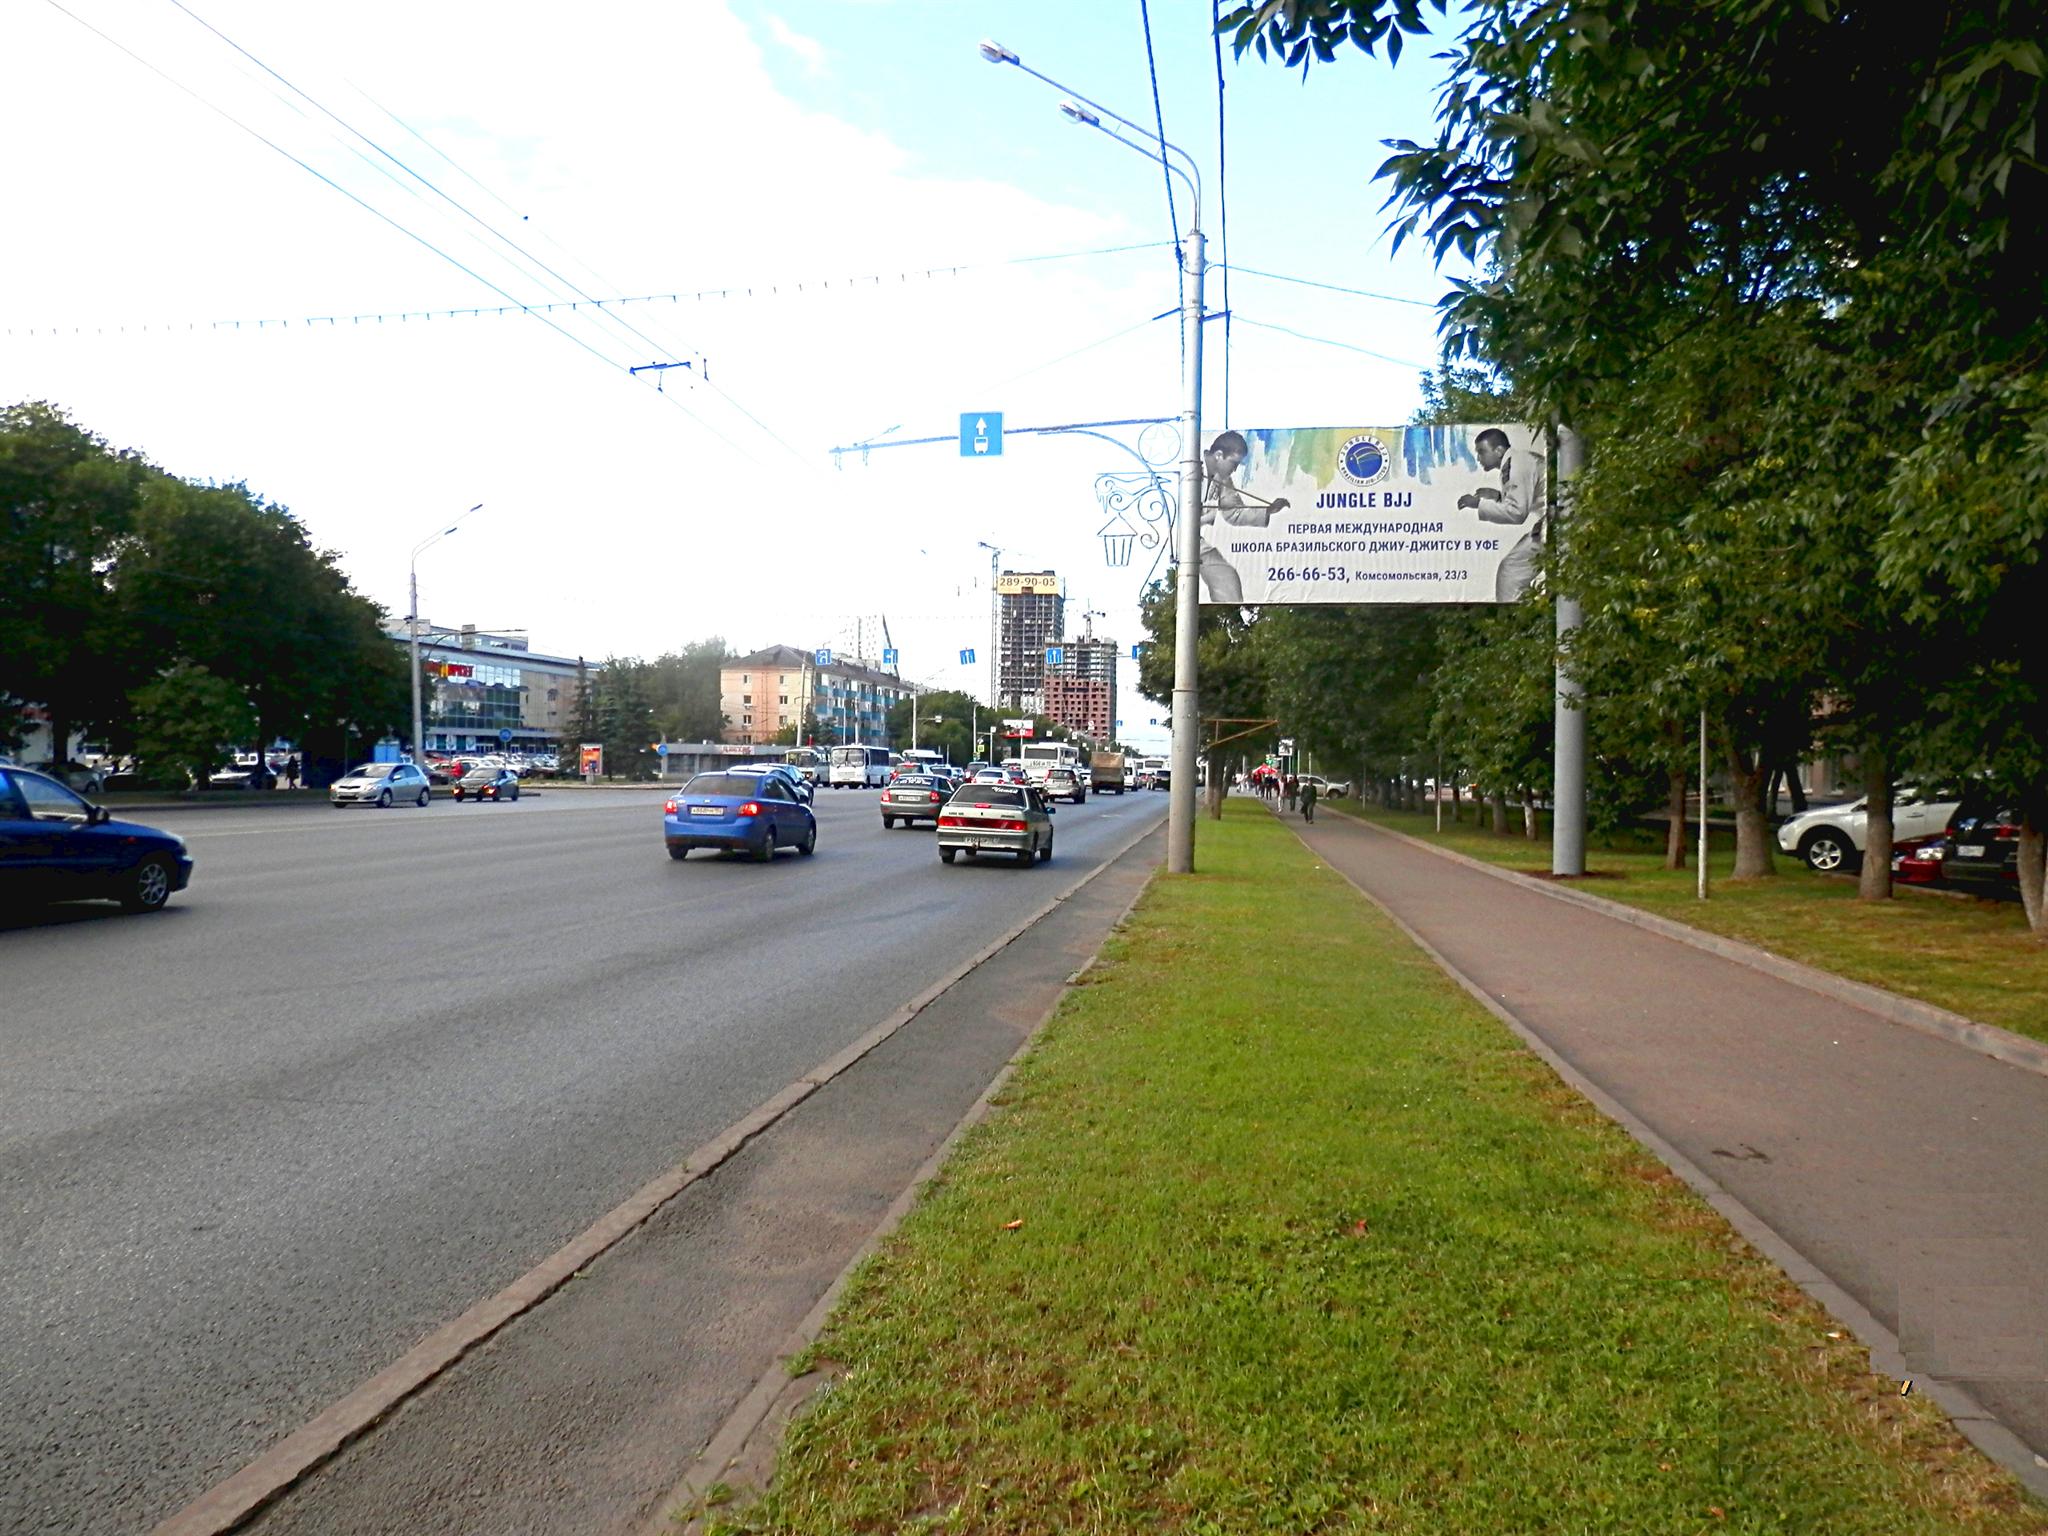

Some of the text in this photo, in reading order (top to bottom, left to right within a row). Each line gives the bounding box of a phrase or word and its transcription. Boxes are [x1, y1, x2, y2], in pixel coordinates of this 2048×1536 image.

[1316, 492, 1412, 508] JUNGLE BJJ
[1288, 522, 1443, 535] ПЕРВАЯ МЕЖДУНАРОДНАЯ
[1231, 540, 1499, 553] ШКОЛА БРАЗИЛЬСКОГО ДЖИУ-ДЖИТСУ В УФЕ
[1000, 577, 1055, 586] 289-90-05
[1268, 567, 1468, 583] 266-66-53, Комсомольская, 23/3
